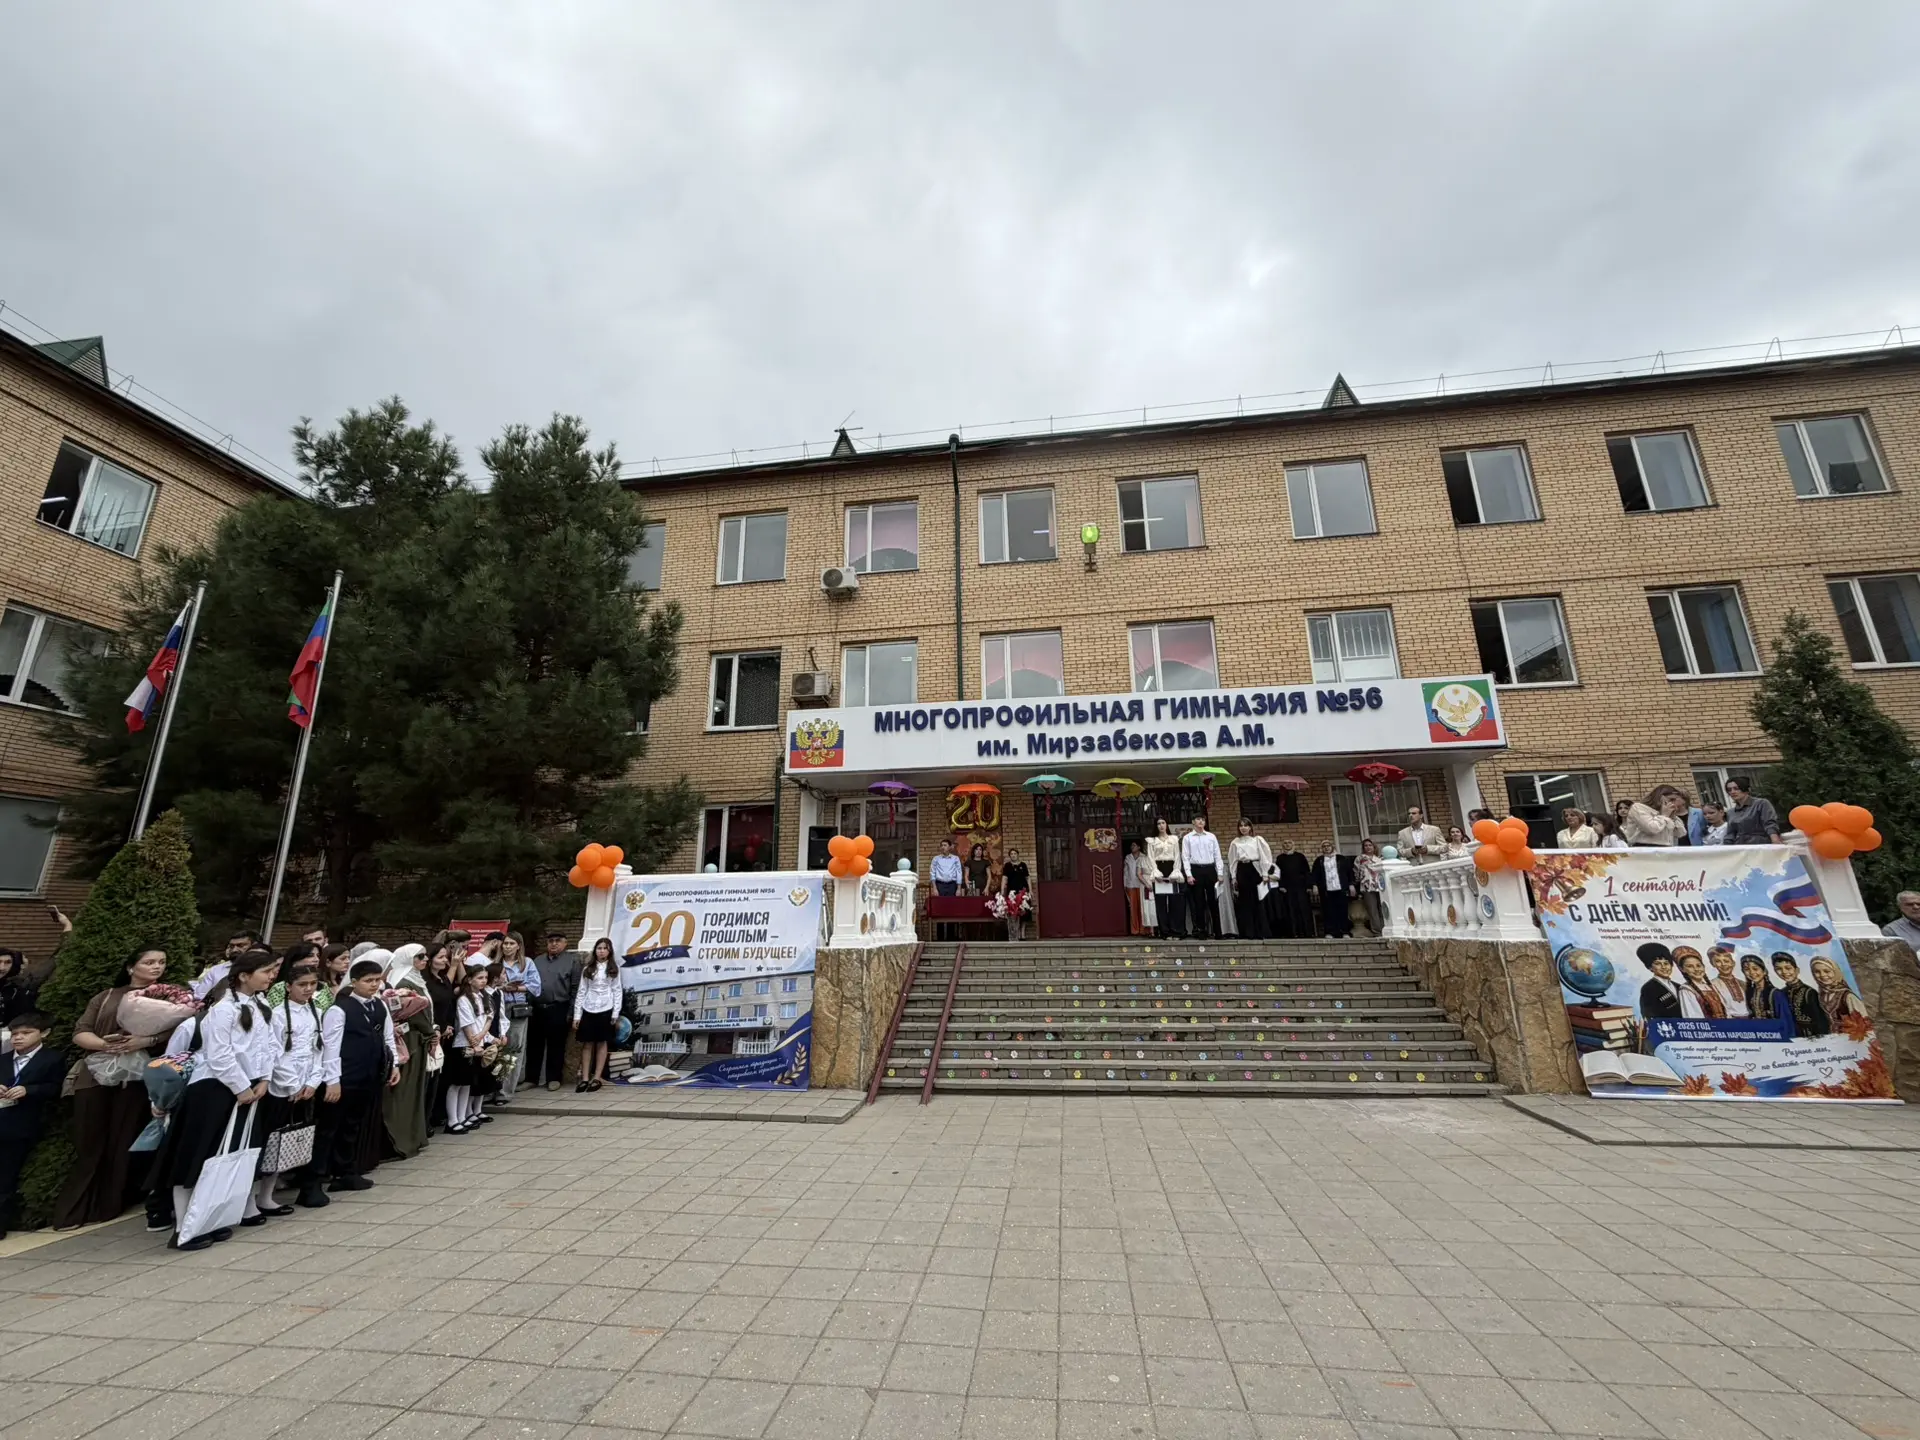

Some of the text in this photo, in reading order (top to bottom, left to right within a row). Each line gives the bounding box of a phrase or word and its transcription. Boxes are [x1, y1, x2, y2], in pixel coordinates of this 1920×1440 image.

[874, 686, 1384, 732] МНОГОПРОФИЛЬНАЯ ГИМНАЗИЯ №56
[977, 723, 1275, 759] им. Мирзабекова А.М.
[946, 793, 1001, 833] 20
[1604, 870, 1706, 898] 1 сентября!
[658, 889, 724, 898] МНОГОПРОФИЛЬНАЯ
[703, 911, 770, 928] ГОРДИМСЯ
[1568, 899, 1732, 924] С ДНЁМ ЗНАНИЙ!
[626, 910, 696, 955] 20
[700, 929, 768, 944] ПРОШЛЫМ
[644, 948, 673, 960] лет
[698, 946, 797, 960] СТРОИМ БУДУЩЕЕ!
[1676, 1022, 1696, 1030] 2026
[1696, 1022, 1711, 1031] ГОД
[1781, 1048, 1812, 1057] Разные
